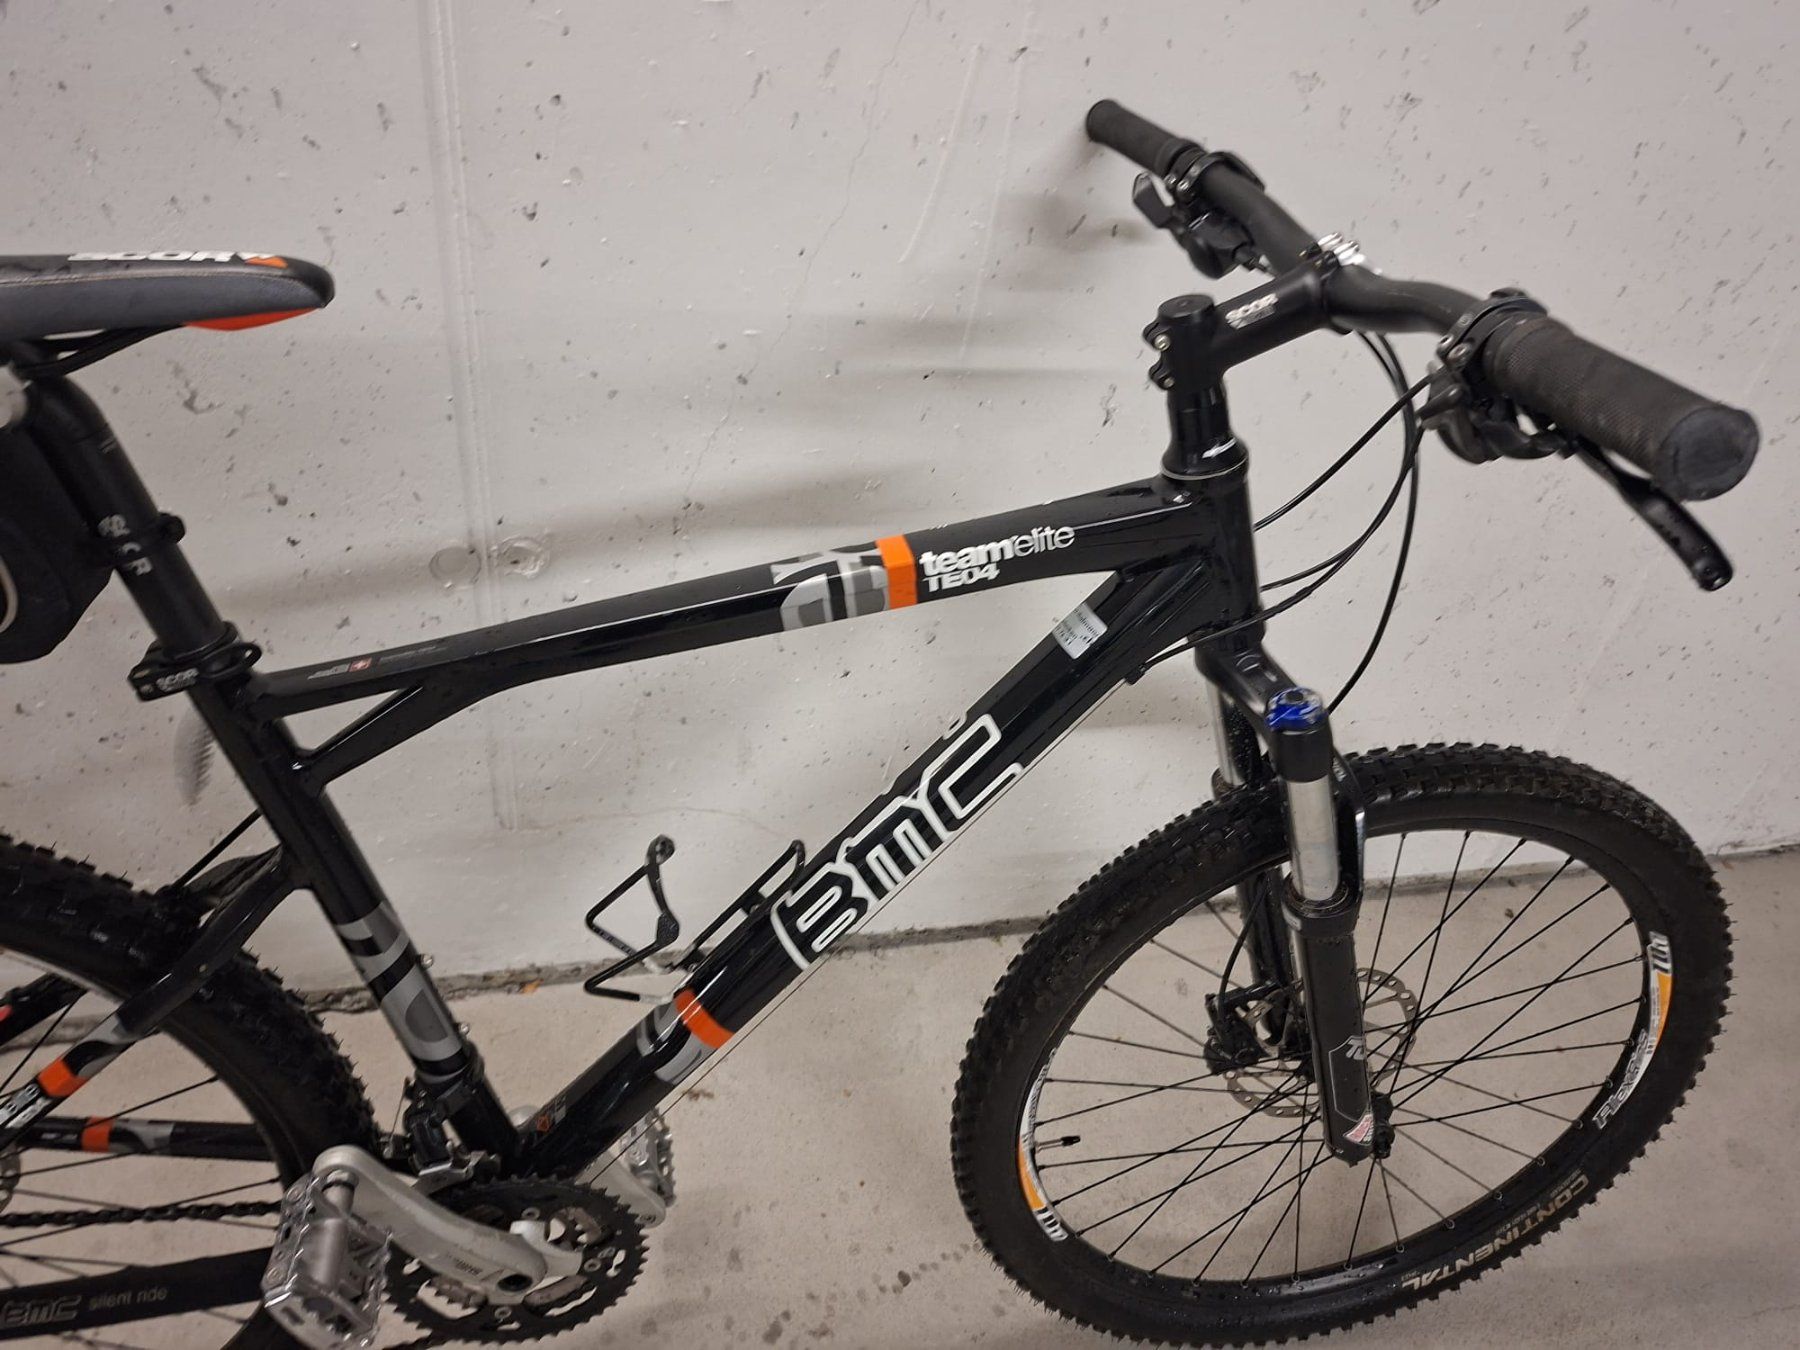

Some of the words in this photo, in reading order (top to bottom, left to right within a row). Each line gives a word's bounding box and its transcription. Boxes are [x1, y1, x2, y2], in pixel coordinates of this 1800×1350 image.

[922, 562, 1000, 593] TE04
[770, 713, 1024, 971] BMC
[1401, 1173, 1590, 1291] CONTINENTAL
